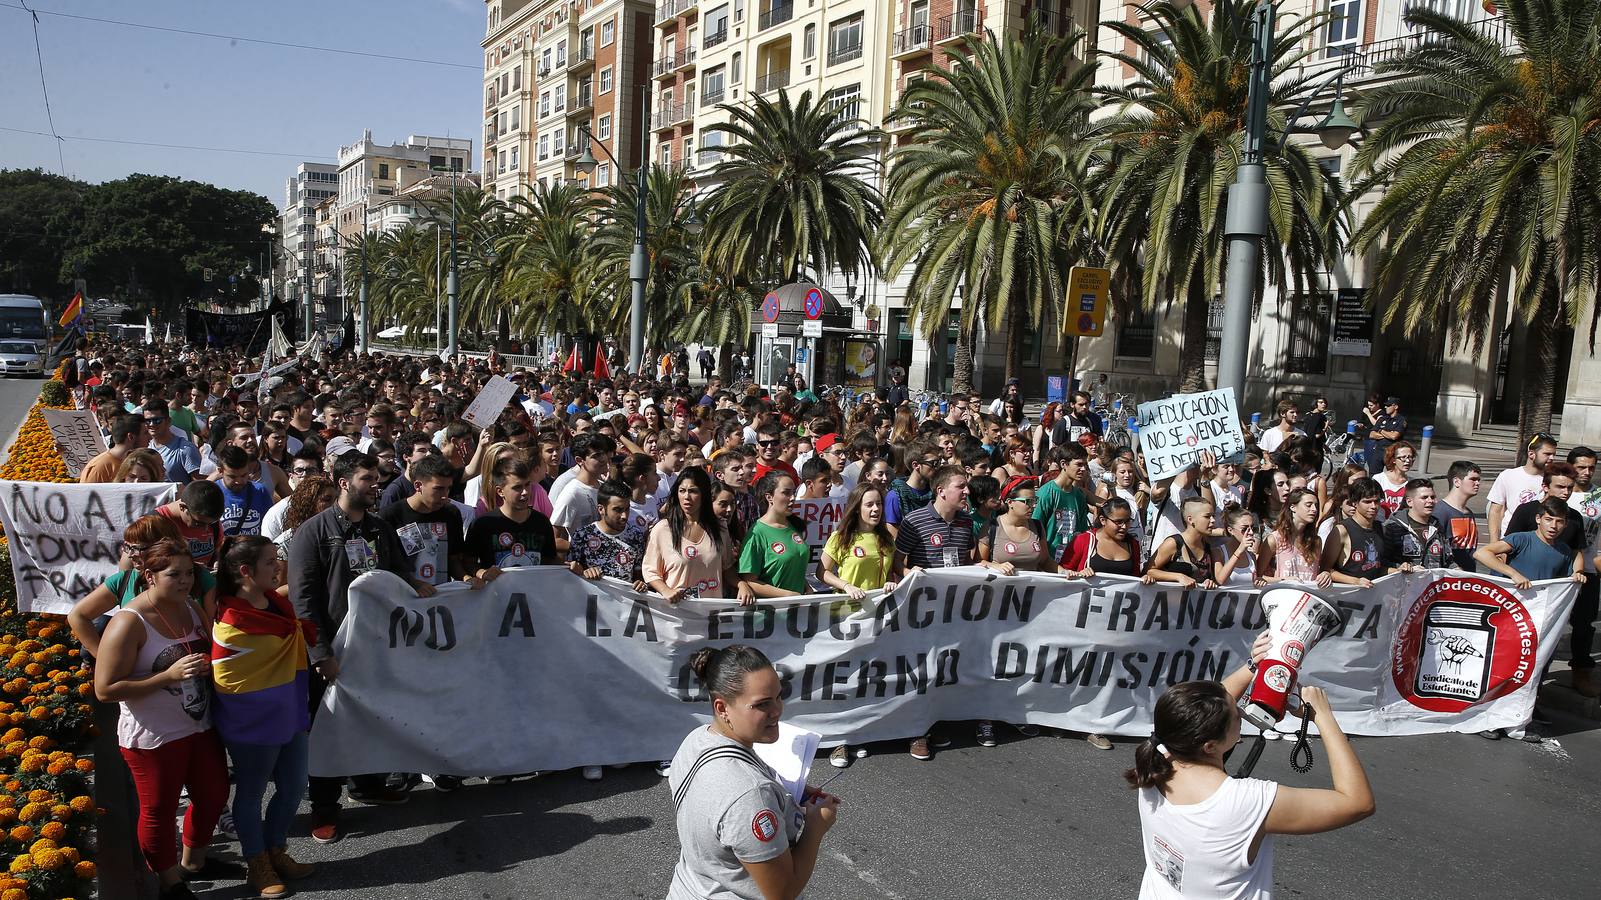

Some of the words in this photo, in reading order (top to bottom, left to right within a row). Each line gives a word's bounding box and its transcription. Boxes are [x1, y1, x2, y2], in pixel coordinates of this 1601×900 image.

[1138, 408, 1156, 428] LA
[1157, 392, 1230, 424] EDUCACIÓN
[1147, 431, 1167, 451] NO
[1169, 425, 1187, 447] SE
[1150, 456, 1170, 475] SE
[11, 483, 69, 525] NO
[84, 490, 115, 532] A
[389, 605, 457, 651] NO
[498, 592, 536, 638] A
[586, 594, 658, 642] LA
[707, 574, 1036, 641] EDUCACIÓN
[1075, 587, 1383, 640] FRANQUTA
[678, 649, 960, 703] GBIERNO
[994, 635, 1231, 690] DIMISIÓN
[1422, 673, 1466, 687] Sindicato
[1465, 677, 1479, 688] de
[1421, 682, 1477, 698] Estudiantes
